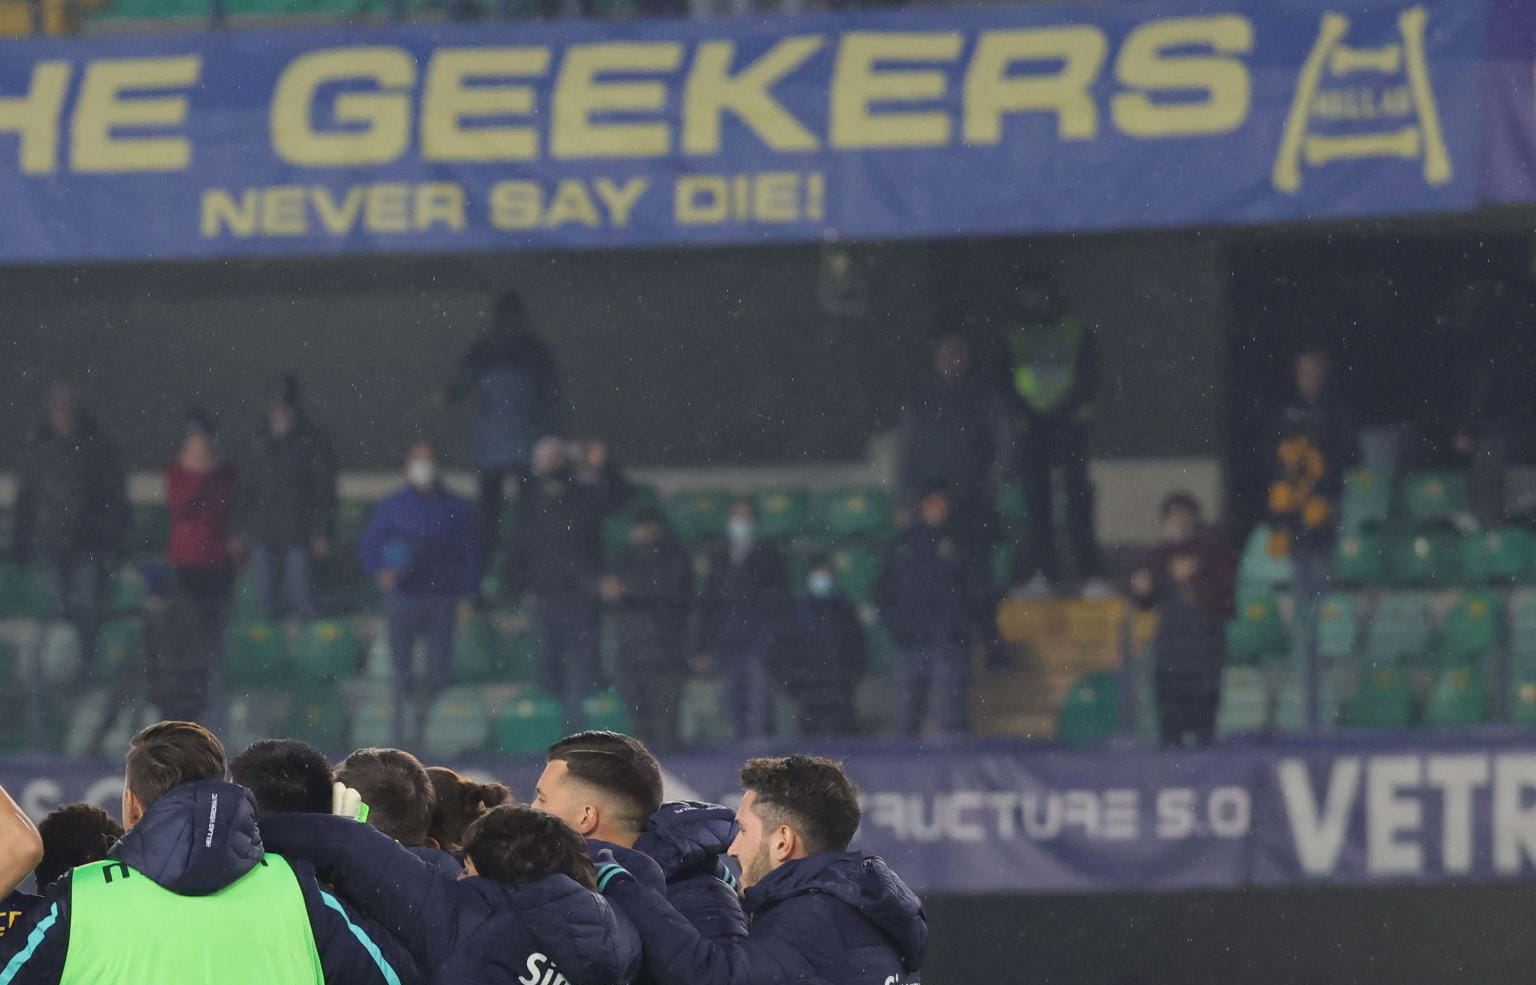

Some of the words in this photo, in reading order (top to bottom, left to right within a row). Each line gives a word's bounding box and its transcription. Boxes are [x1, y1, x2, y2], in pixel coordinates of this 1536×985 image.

[271, 14, 1253, 167] GEEKERS
[199, 182, 467, 238] NEVER
[489, 176, 651, 230] SAY
[674, 172, 825, 225] DIE!
[857, 787, 1141, 842] RUCTURE
[1155, 786, 1252, 839] 5.0
[1277, 752, 1536, 878] VETR
